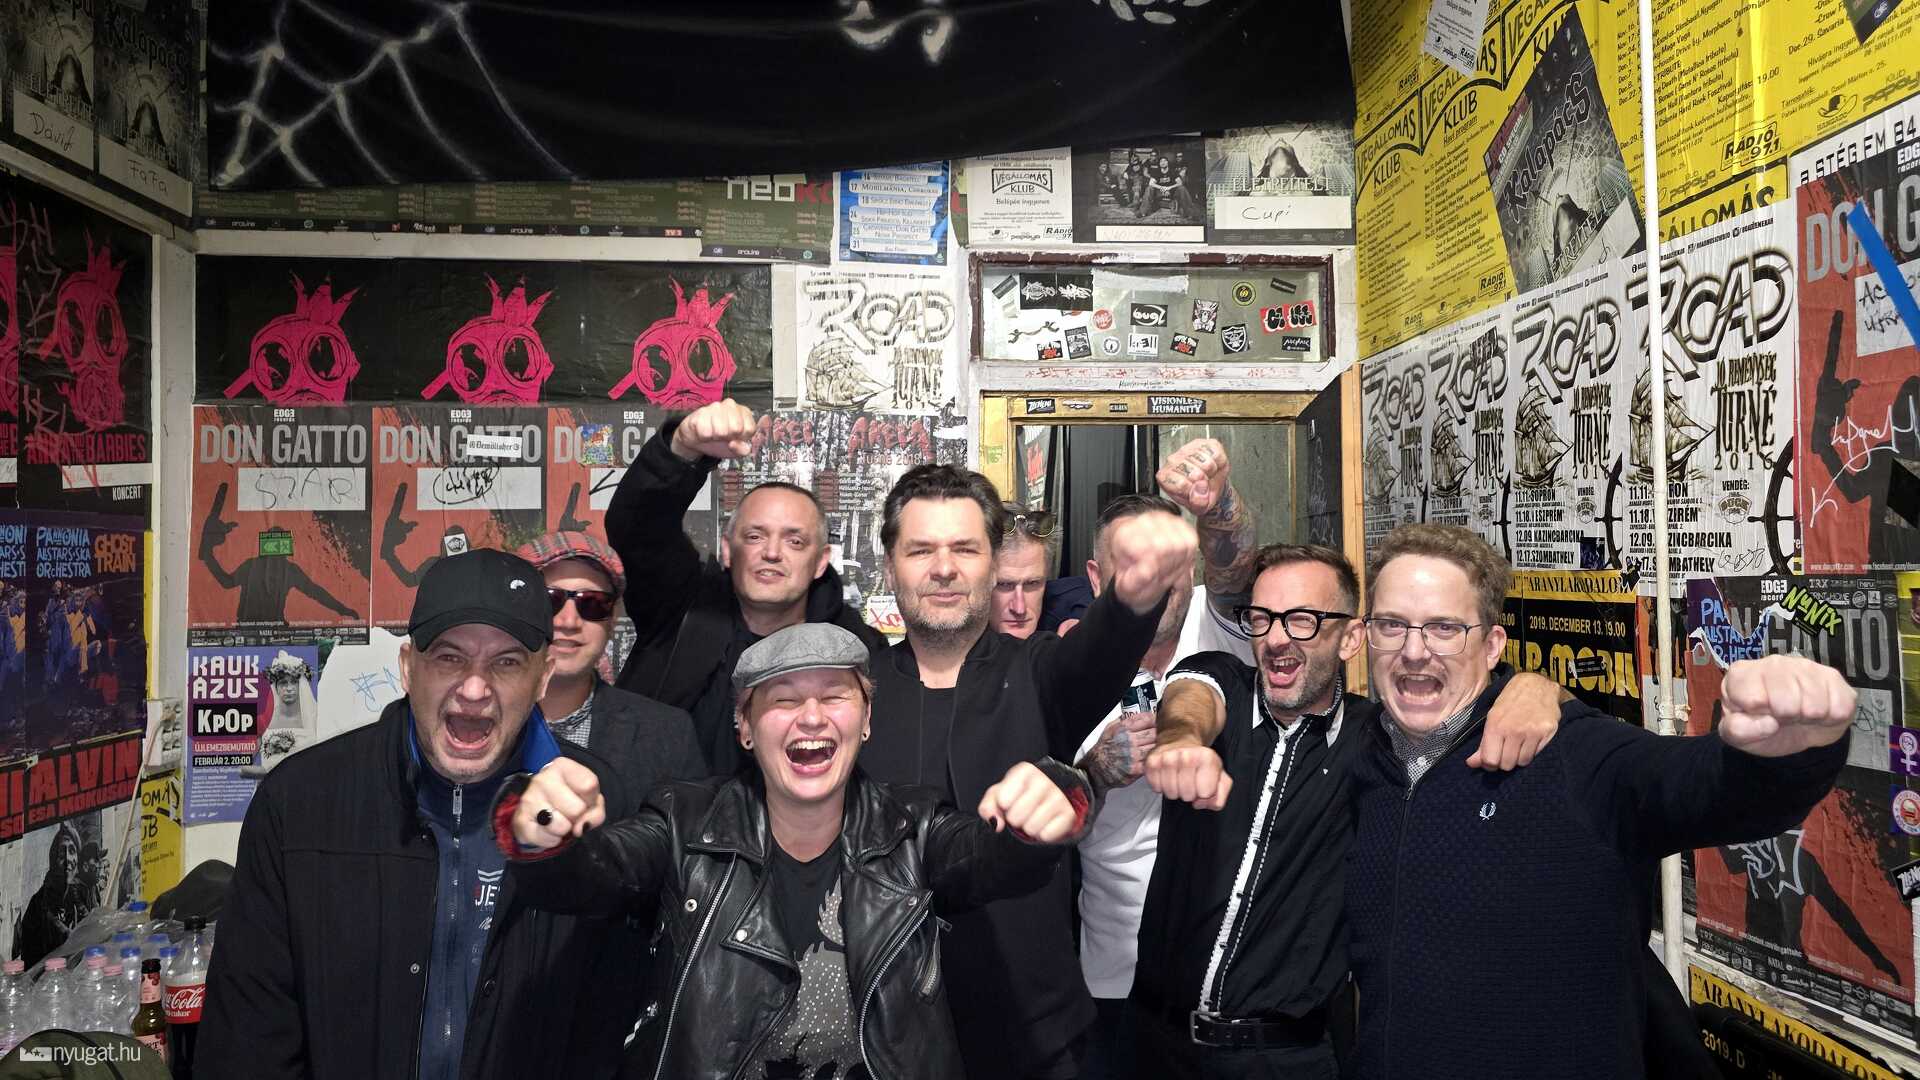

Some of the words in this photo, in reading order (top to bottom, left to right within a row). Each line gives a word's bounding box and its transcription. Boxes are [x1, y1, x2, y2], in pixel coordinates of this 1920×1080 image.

[1443, 90, 1478, 133] KLUB
[1356, 109, 1416, 184] VÉGÁLLOMÁS
[1505, 72, 1591, 223] Kalapács
[1724, 126, 1774, 160] RÁDIÓ
[1751, 137, 1780, 159] 97.1
[1863, 128, 1886, 160] FM
[1373, 153, 1401, 189] KLUB
[1011, 184, 1035, 193] KLUB
[1513, 296, 1623, 405] ROAD
[1151, 404, 1201, 415] HUMANITY
[1710, 382, 1776, 453] TURNÉ
[200, 424, 264, 464] DON
[271, 424, 368, 464] GATTO
[379, 425, 441, 464] DON
[1570, 406, 1611, 467] TURNÉ
[896, 453, 921, 465] 2018
[1714, 450, 1774, 471] 2016
[112, 485, 142, 502] KONCERT
[1722, 479, 1750, 492] VENDÉG:
[95, 533, 135, 554] GHOST
[1534, 529, 1585, 543] KAZINCBARCIKA
[95, 553, 136, 573] TRAIN
[1532, 550, 1575, 565] SZOMBATHELY
[1529, 615, 1548, 630] 2019.
[1549, 616, 1591, 635] DECEMBER
[1604, 620, 1626, 638] 19.00
[192, 655, 260, 677] KAUK
[29, 738, 139, 806] ALVIN
[194, 756, 223, 766] FEBRUÁR
[224, 757, 230, 766] 2.
[231, 756, 251, 766] 20:00
[171, 986, 207, 1010] Cola
